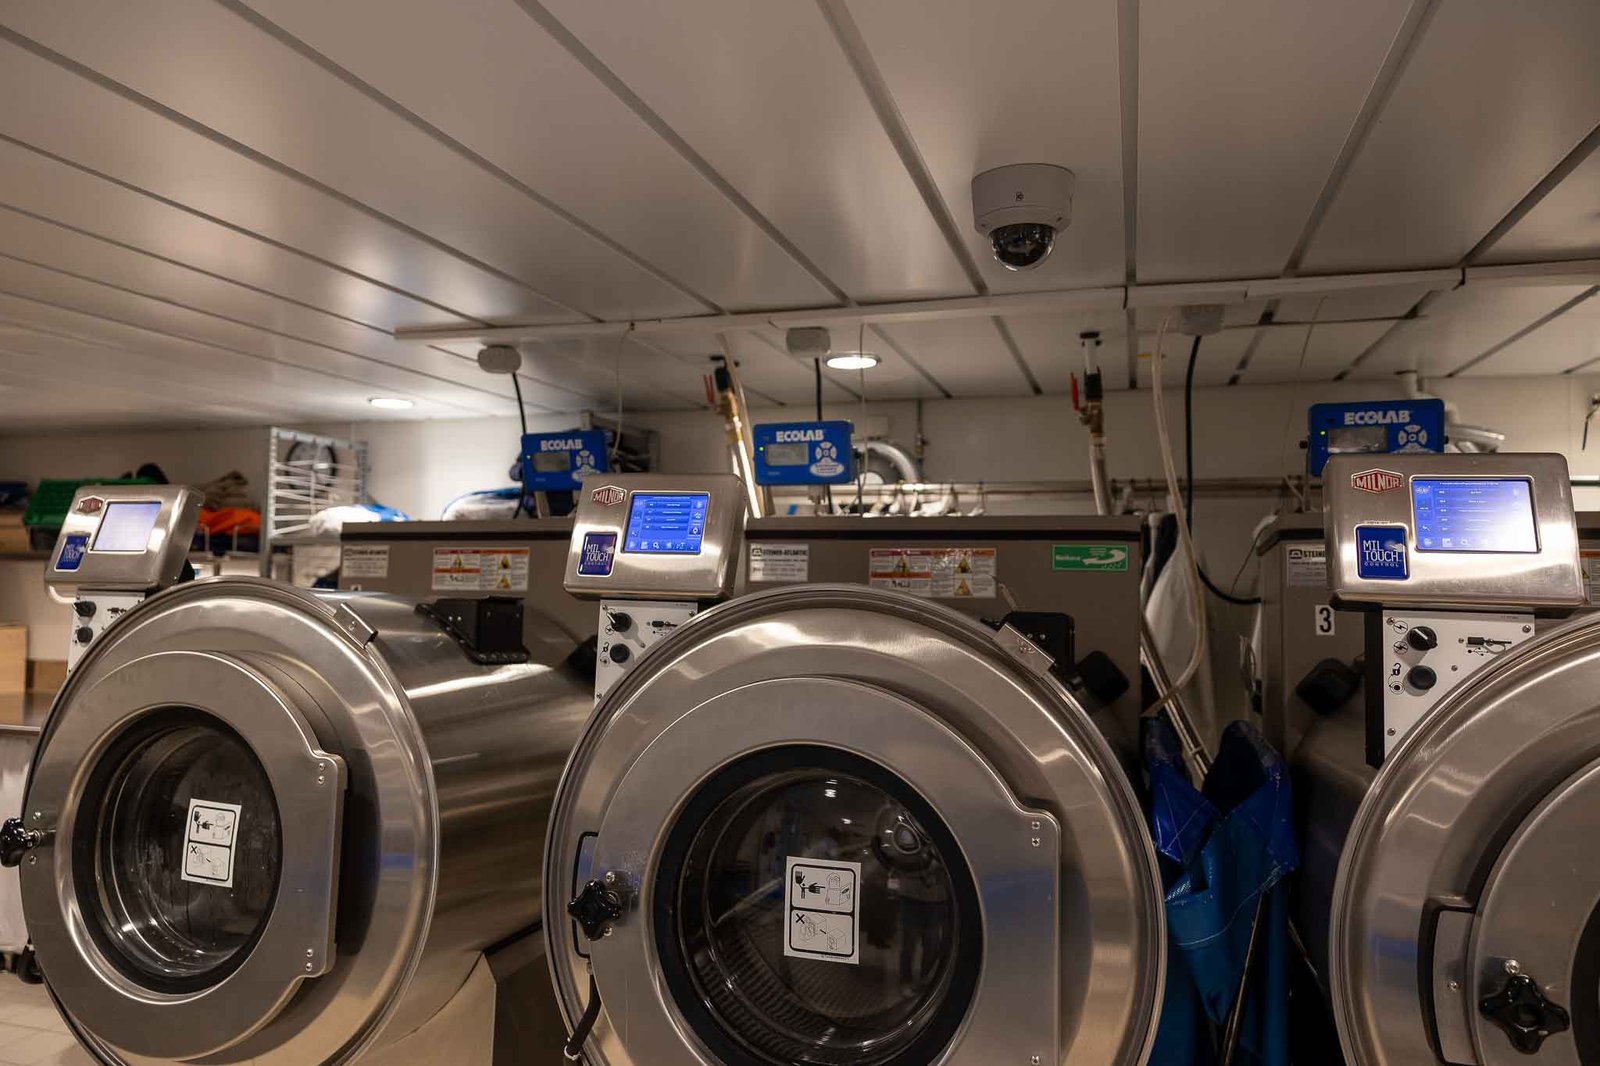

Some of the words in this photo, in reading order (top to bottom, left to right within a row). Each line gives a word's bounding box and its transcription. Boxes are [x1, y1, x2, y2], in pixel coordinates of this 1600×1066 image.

[1344, 410, 1410, 425] ECOLAB
[776, 429, 824, 442] ECOLAB
[540, 438, 583, 451] ECOLAB
[1356, 473, 1400, 492] MILNOR
[593, 490, 624, 504] MILNOR
[586, 543, 600, 553] MIL
[1363, 539, 1384, 552] MIL
[586, 552, 609, 562] TOUCH
[1364, 550, 1399, 562] TOUCH
[1319, 607, 1332, 633] 3
